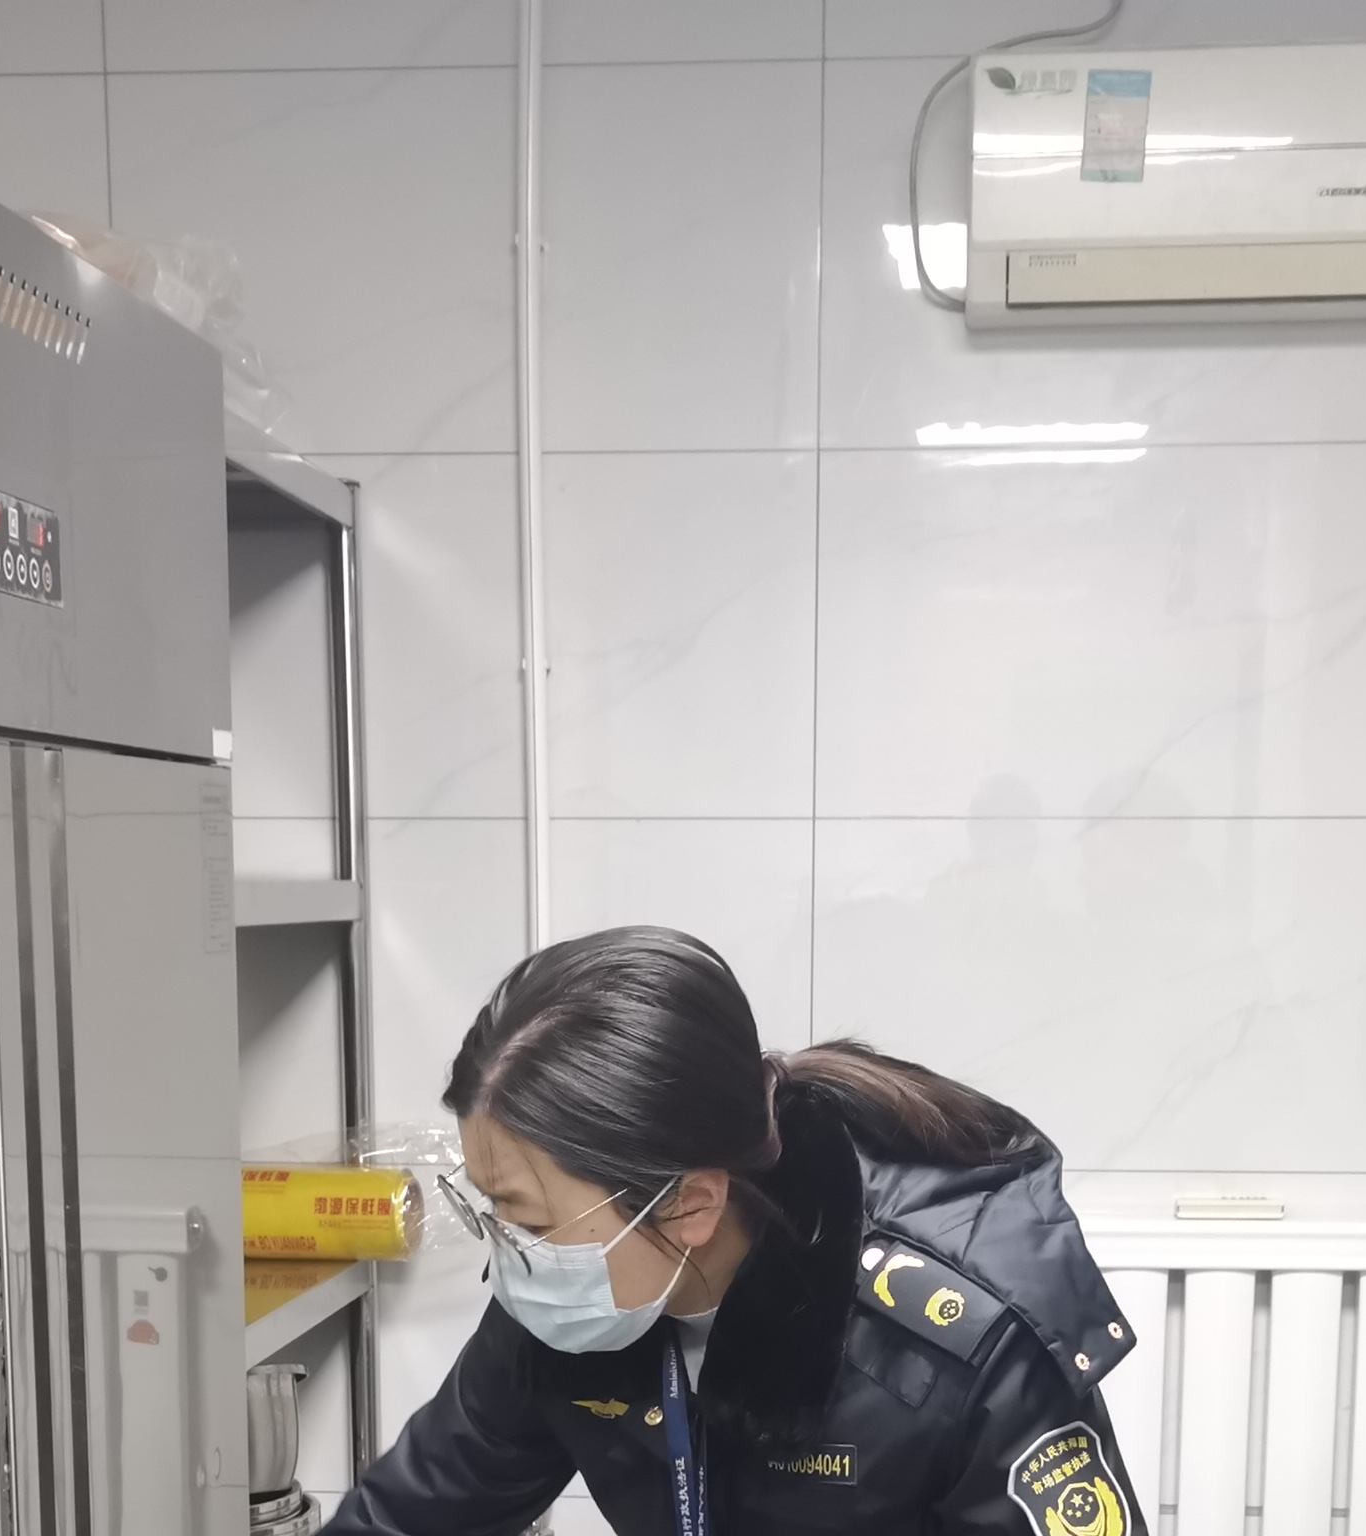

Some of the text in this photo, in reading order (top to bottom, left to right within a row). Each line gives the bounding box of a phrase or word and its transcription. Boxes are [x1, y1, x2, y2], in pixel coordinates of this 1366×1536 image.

[1021, 1436, 1089, 1483] 中华人民共和国
[1031, 1450, 1092, 1496] 市场监管执法
